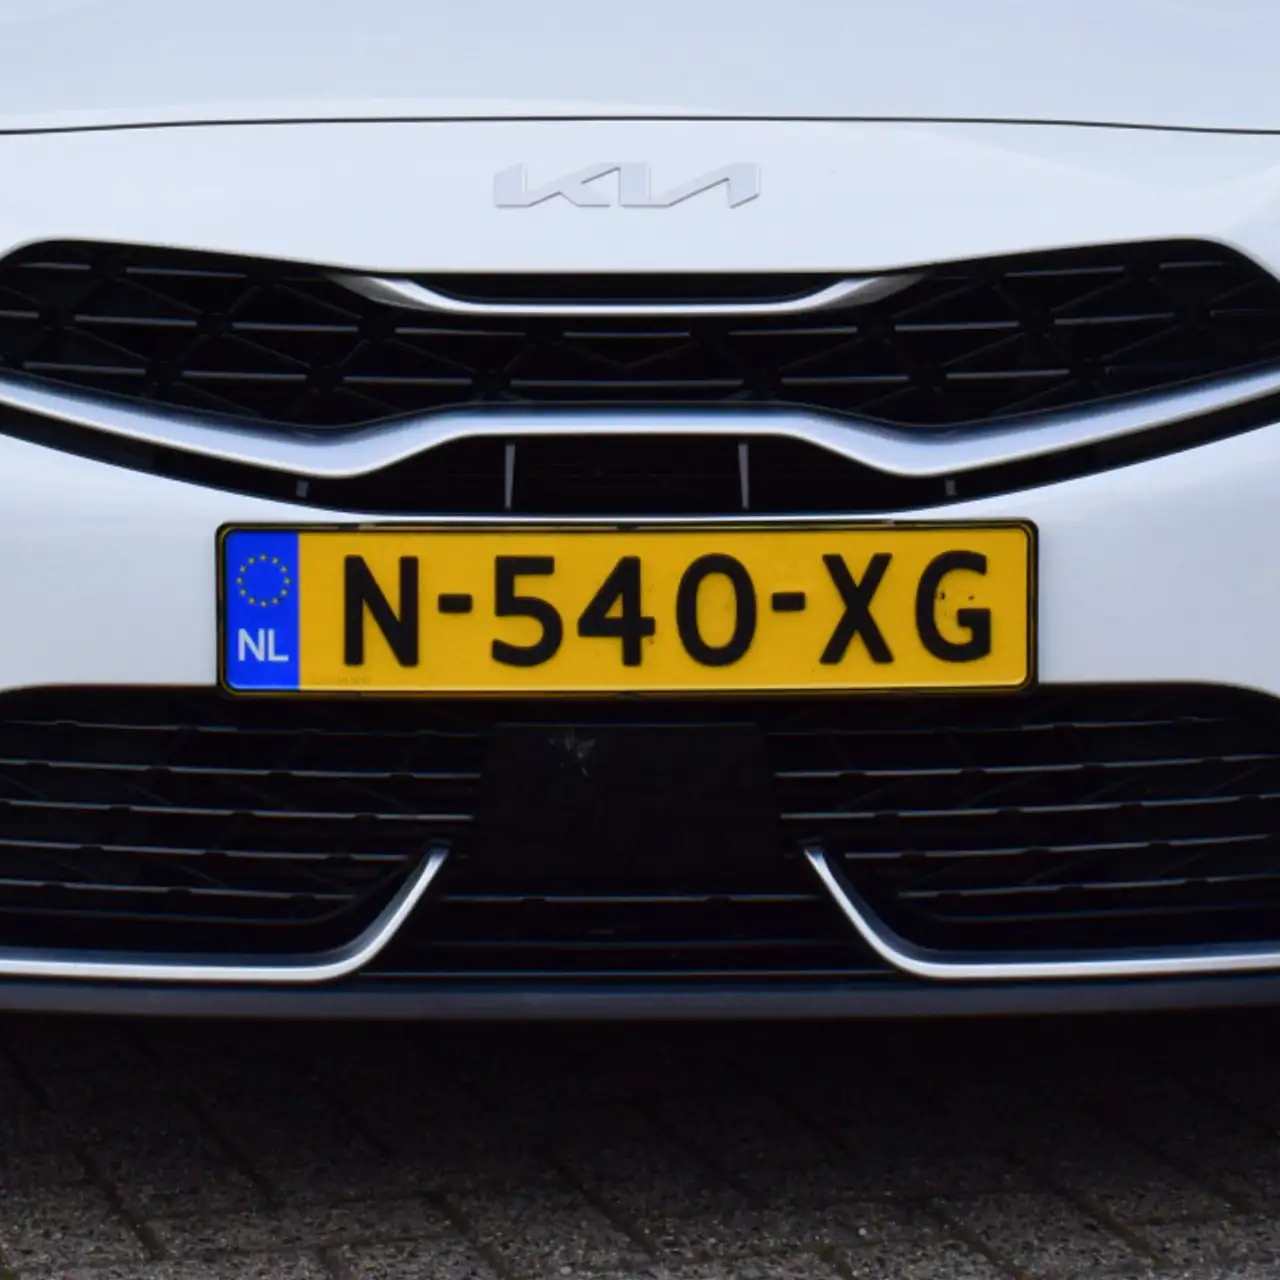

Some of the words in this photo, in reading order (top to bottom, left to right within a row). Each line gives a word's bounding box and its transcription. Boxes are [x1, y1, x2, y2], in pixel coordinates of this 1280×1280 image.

[493, 161, 762, 209] KIA
[238, 628, 289, 662] NL
[342, 550, 993, 668] N-540-XG
